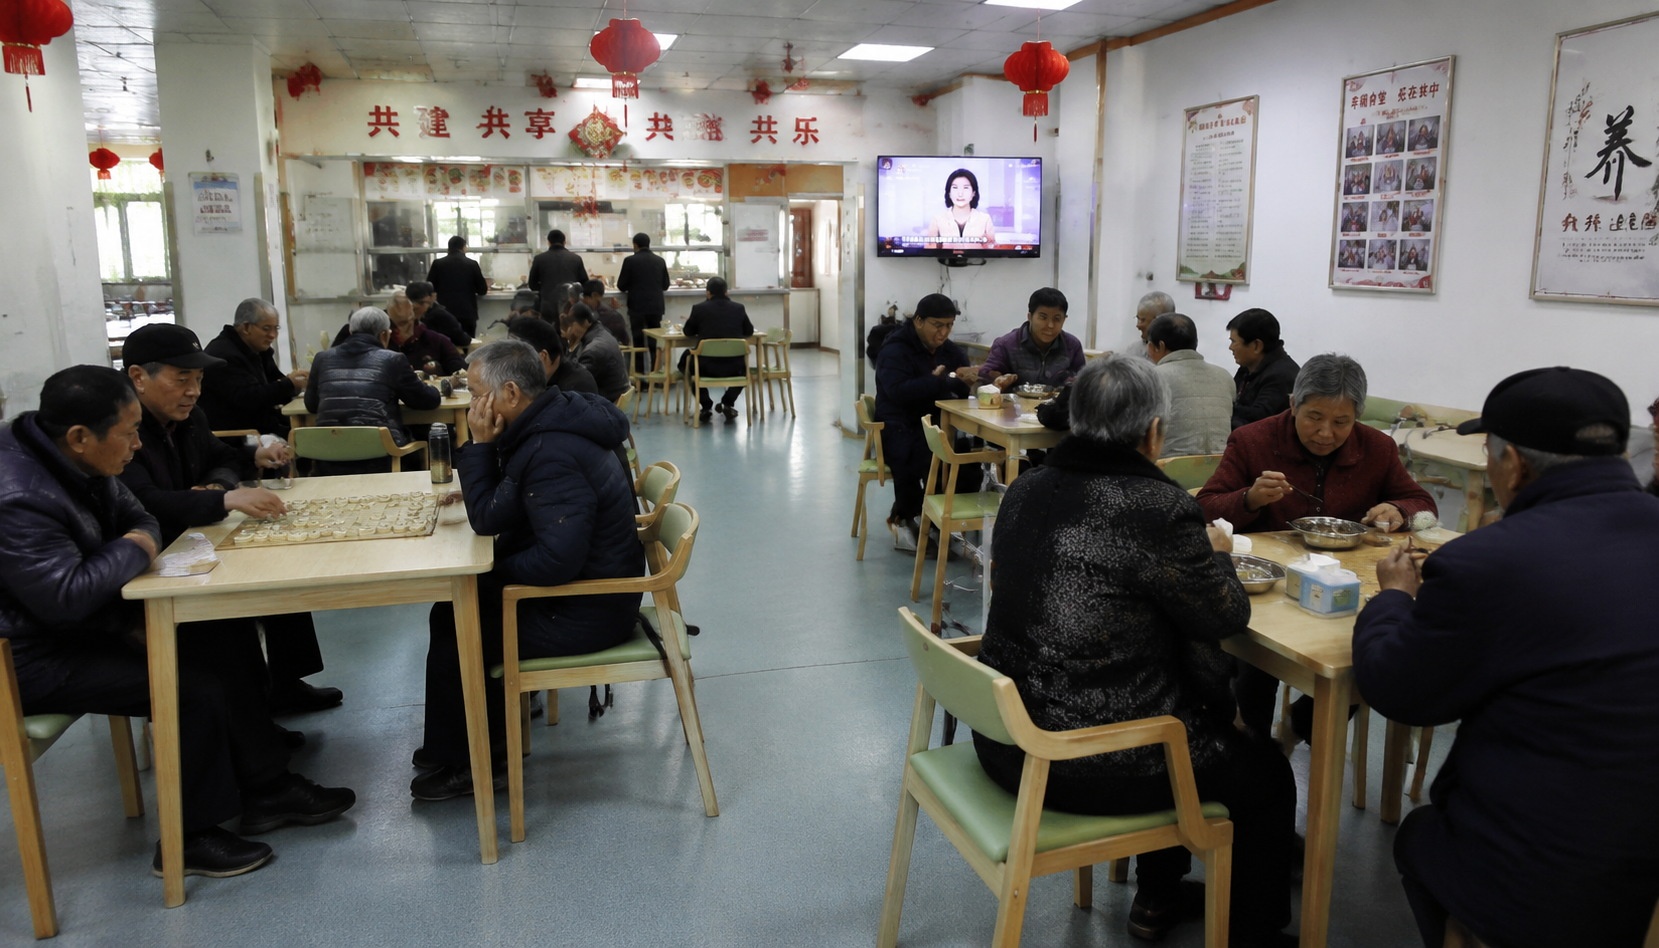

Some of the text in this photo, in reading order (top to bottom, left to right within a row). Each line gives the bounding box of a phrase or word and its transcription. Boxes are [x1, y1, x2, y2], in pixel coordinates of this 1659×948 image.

[476, 105, 556, 139] 共享
[749, 115, 820, 145] 共乐
[1584, 104, 1652, 201] 养
